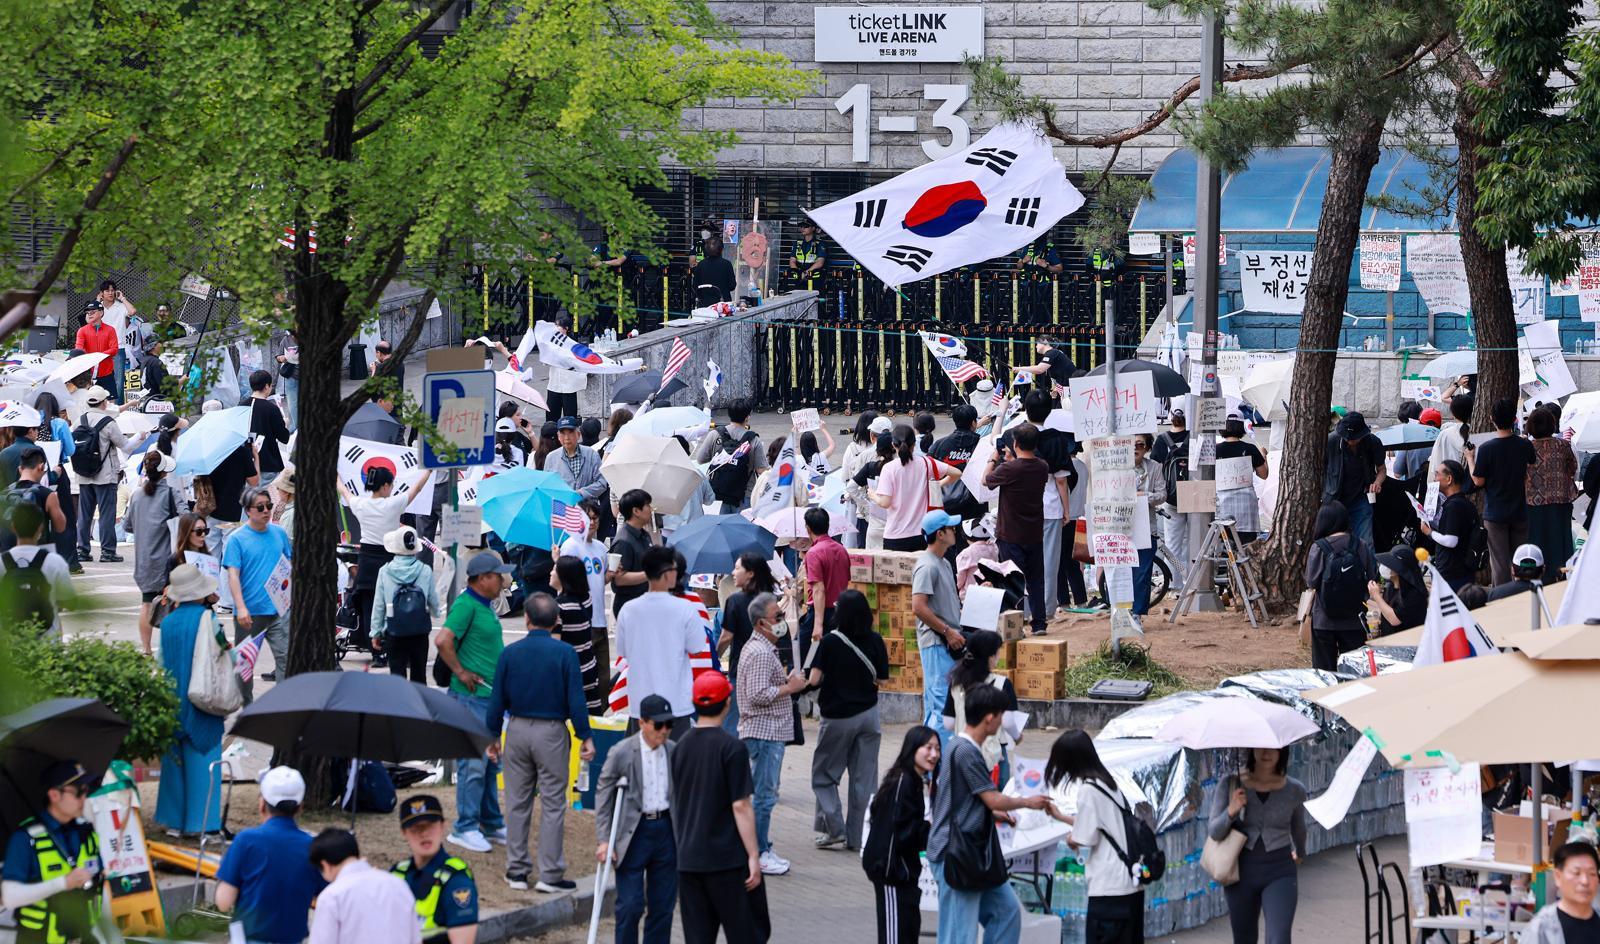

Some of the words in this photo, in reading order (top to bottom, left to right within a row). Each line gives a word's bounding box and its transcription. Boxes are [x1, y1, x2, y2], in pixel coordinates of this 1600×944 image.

[849, 13, 947, 30] ticketLINK
[858, 32, 888, 43] LIVE
[890, 32, 937, 43] ARENA
[879, 48, 897, 56] 핸드볼
[899, 48, 917, 57] 경기장
[834, 83, 971, 162] 1-3
